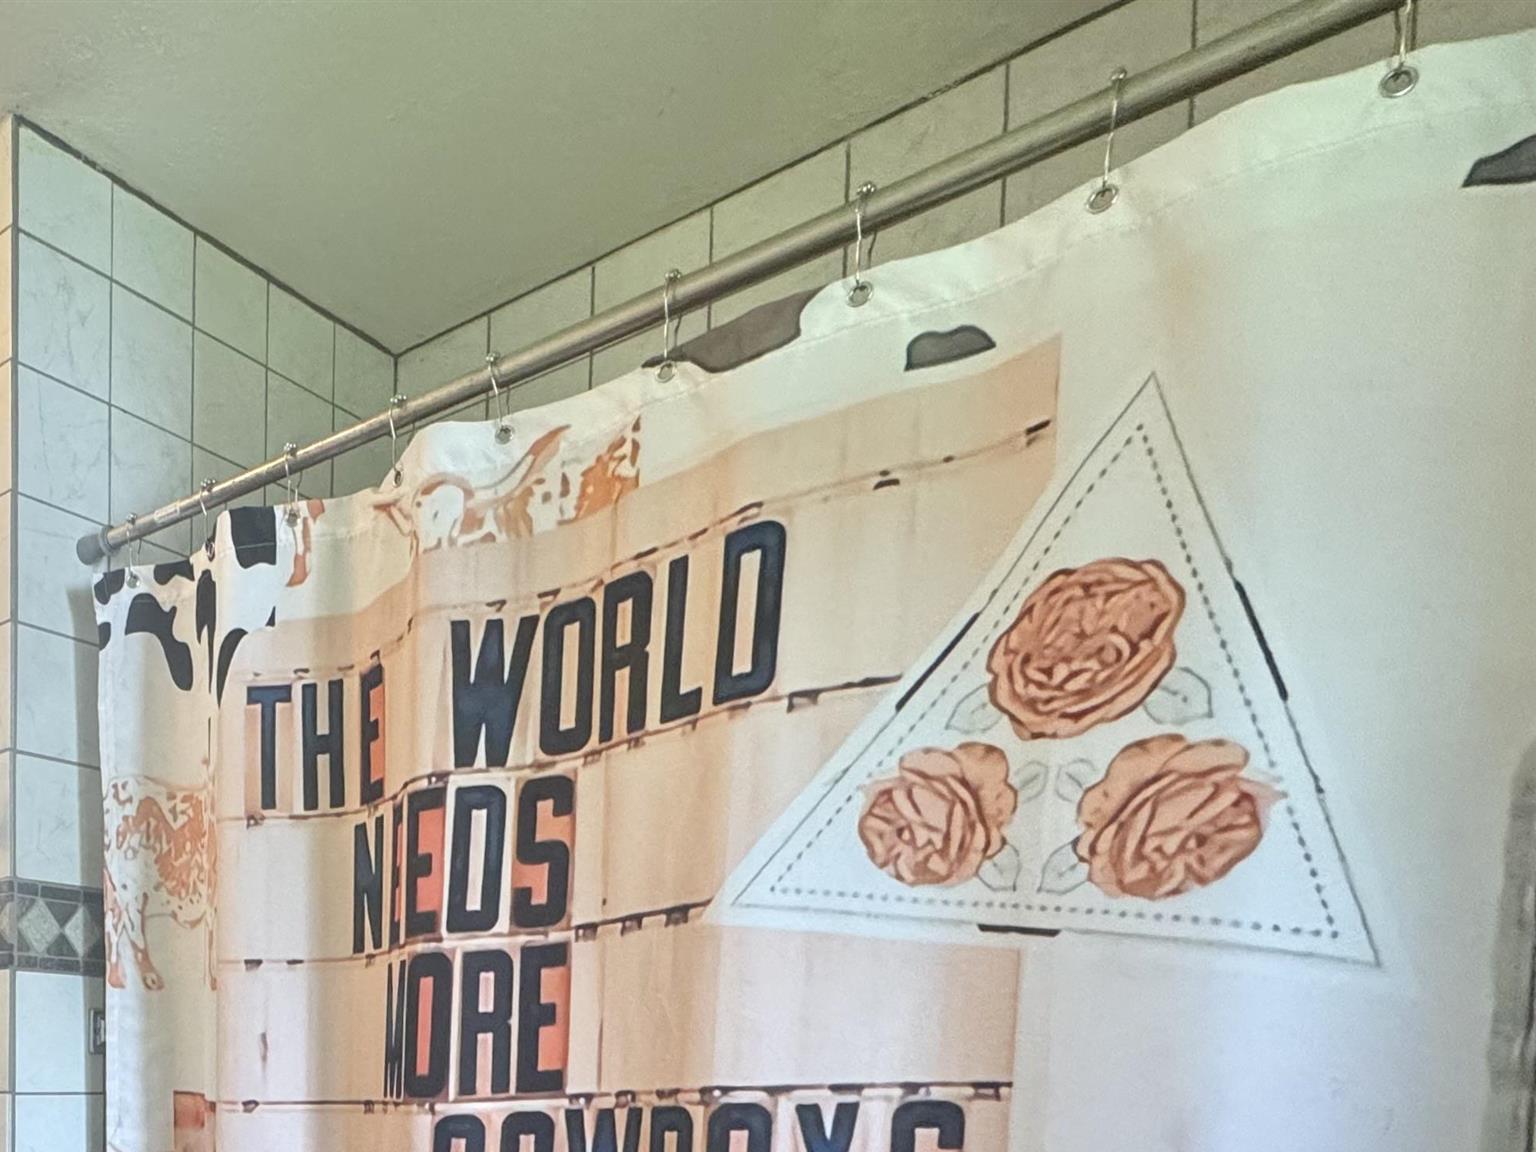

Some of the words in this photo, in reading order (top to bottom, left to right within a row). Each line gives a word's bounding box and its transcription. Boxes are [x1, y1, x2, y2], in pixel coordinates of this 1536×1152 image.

[245, 662, 386, 811] THE
[450, 519, 787, 769] WORLD
[352, 775, 576, 954] NEEDS
[383, 943, 568, 1099] MORE
